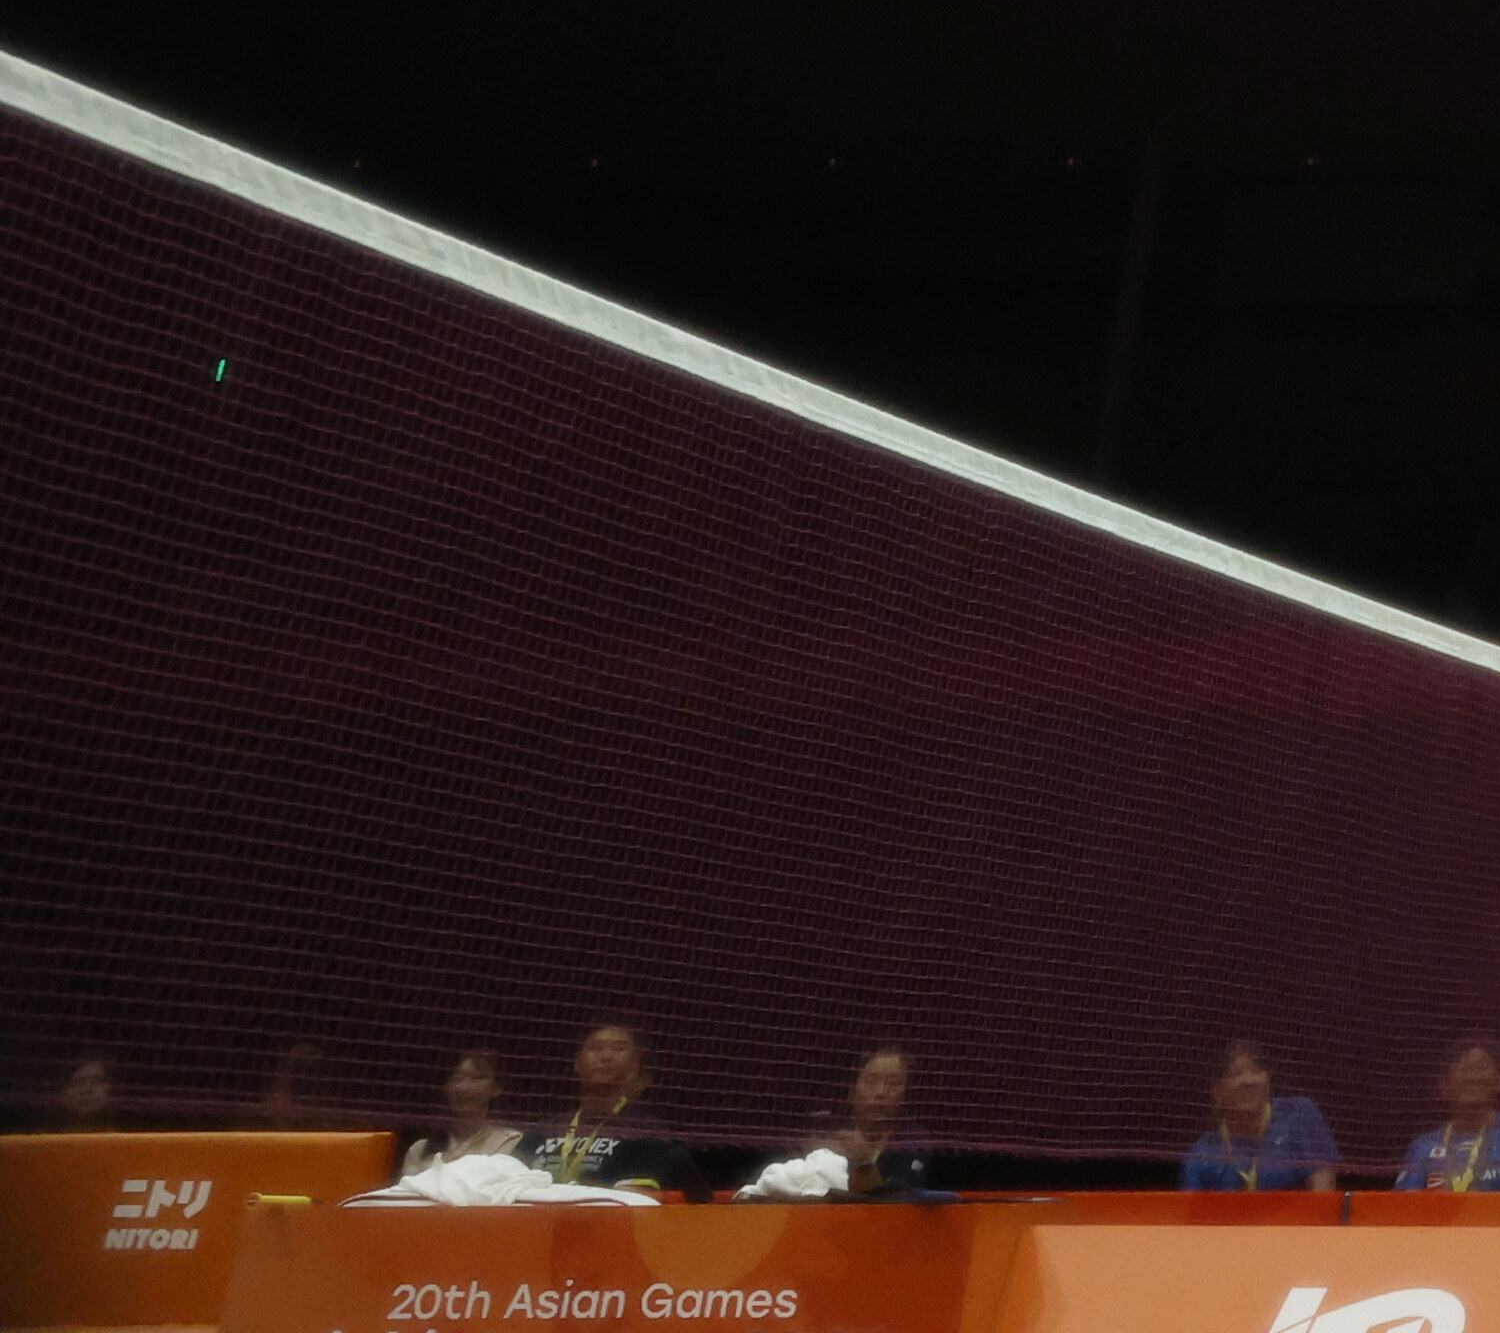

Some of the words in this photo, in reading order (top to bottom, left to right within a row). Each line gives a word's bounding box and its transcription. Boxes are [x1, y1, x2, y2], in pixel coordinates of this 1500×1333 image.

[112, 1179, 213, 1219] ニトリ
[104, 1228, 199, 1250] NITORI
[386, 1280, 491, 1320] 20th
[503, 1279, 626, 1320] Asian
[640, 1282, 799, 1319] Games
